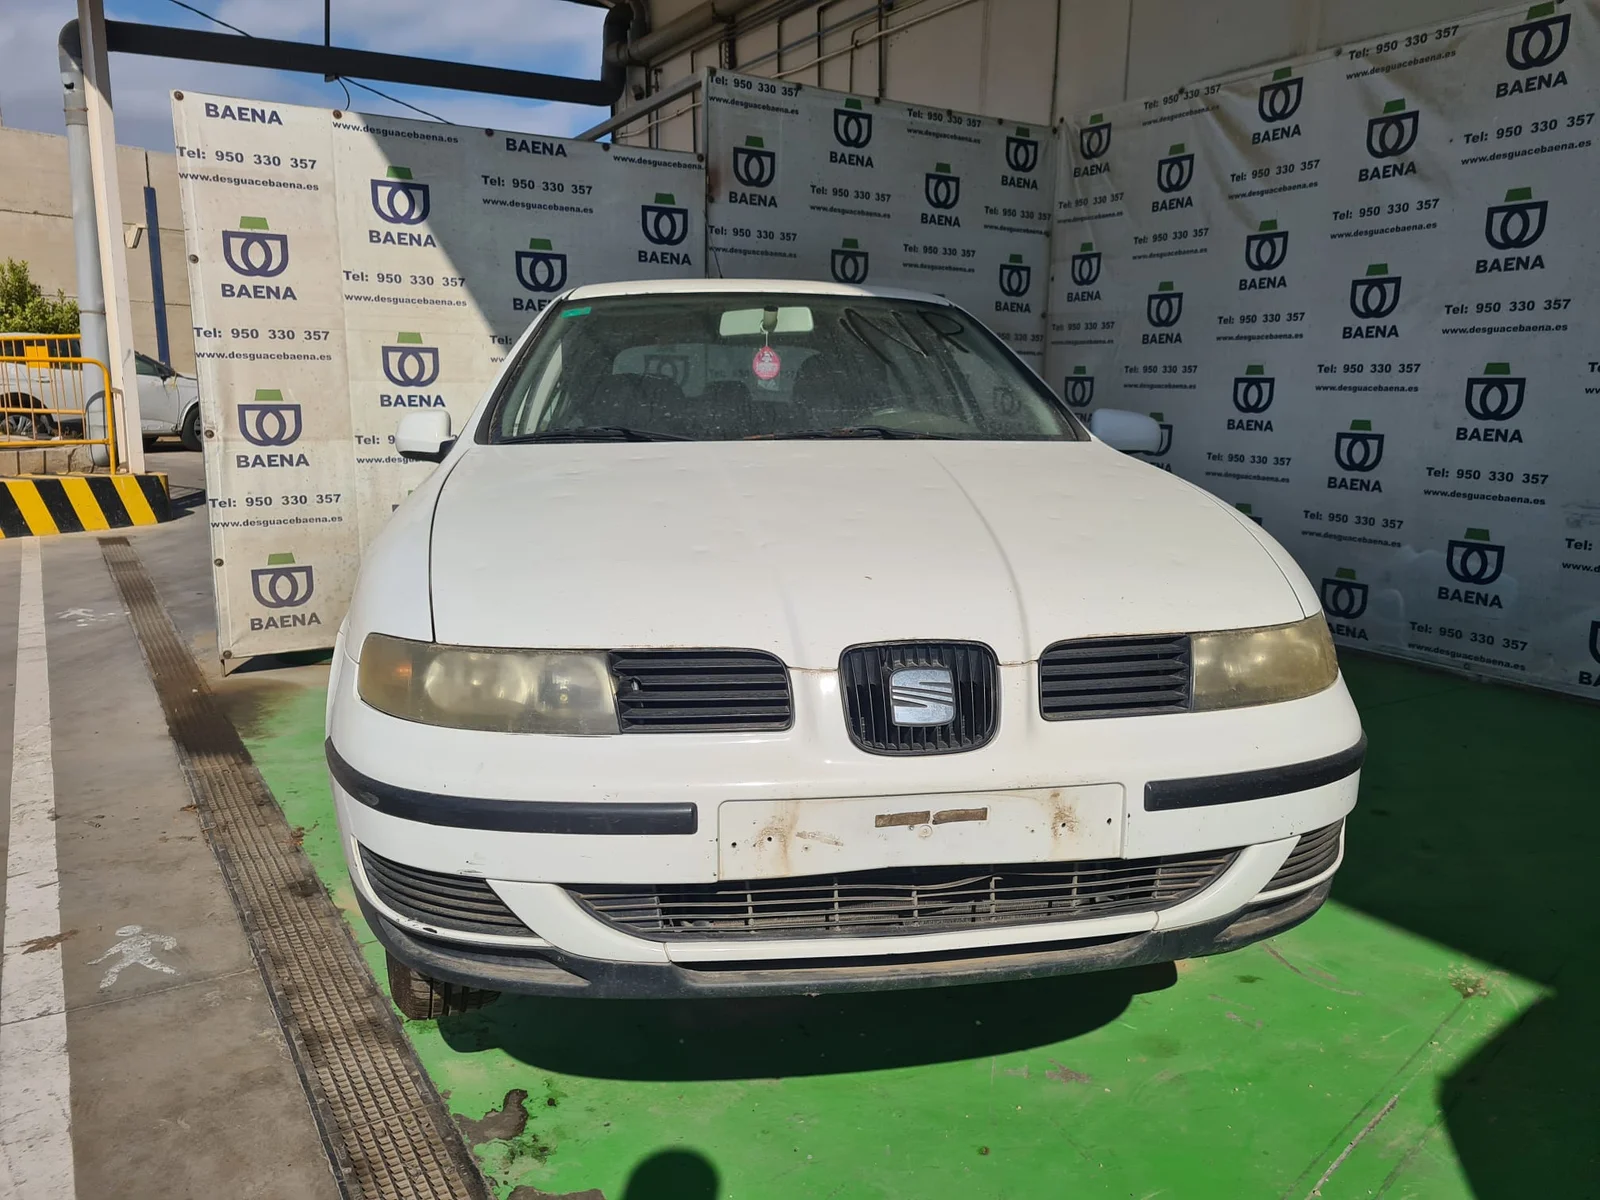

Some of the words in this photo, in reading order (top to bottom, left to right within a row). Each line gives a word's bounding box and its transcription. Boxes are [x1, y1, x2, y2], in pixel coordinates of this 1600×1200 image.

[1349, 48, 1369, 60] Tel:
[1376, 40, 1398, 54] 950
[1405, 33, 1427, 47] 330
[1435, 25, 1459, 41] 357
[1346, 50, 1456, 80] www.desguacebaena.es
[710, 74, 728, 86] Tel:
[733, 78, 752, 90] 950
[758, 82, 776, 94] 330
[781, 86, 800, 98] 357
[1496, 71, 1568, 98] BAENA
[1144, 101, 1159, 110] Tel:
[1162, 94, 1179, 105] 950
[1184, 89, 1200, 100] 330
[1204, 84, 1221, 95] 357
[204, 102, 283, 126] BAENA
[907, 108, 923, 119] Tel:
[927, 112, 943, 122] 950
[966, 118, 982, 128] 357
[332, 121, 459, 144] www.desguacebaena.es
[1252, 124, 1301, 145] BAENA
[1464, 131, 1488, 144] Tel:
[1496, 125, 1522, 139] 950
[1531, 120, 1557, 133] 330
[1566, 113, 1595, 127] 357
[506, 138, 567, 158] BAENA
[1461, 140, 1591, 165] www.desguacebaena.es
[176, 146, 206, 159] Tel:
[215, 150, 244, 163] 950
[253, 154, 281, 166] 330
[290, 157, 317, 170] 357
[613, 154, 704, 171] www.desguacebaena.
[829, 151, 874, 168] BAENA
[1073, 162, 1111, 178] BAENA
[1230, 173, 1247, 183] Tel:
[1252, 168, 1270, 179] 950
[1276, 164, 1295, 175] 330
[1300, 159, 1320, 171] 357
[1358, 161, 1416, 182] BAENA
[178, 172, 319, 191] www.desguacebaena.es
[481, 174, 505, 187] Tel:
[512, 178, 535, 190] 950
[542, 181, 564, 193] 330
[571, 184, 593, 195] 357
[1001, 175, 1038, 190] BAENA
[729, 191, 778, 208] BAENA
[810, 184, 828, 195] Tel:
[832, 188, 849, 198] 950
[854, 190, 870, 200] 330
[875, 192, 891, 202] 357
[482, 198, 594, 214] www.desguacebaena.es
[984, 206, 999, 215] Tel:
[1002, 208, 1017, 217] 950
[1020, 210, 1034, 219] 330
[1152, 196, 1193, 213] BAENA
[1332, 210, 1352, 221] Tel:
[1359, 206, 1380, 218] 950
[1387, 202, 1409, 214] 330
[1416, 198, 1440, 211] 357
[920, 213, 961, 228] BAENA
[368, 229, 437, 248] BAENA
[708, 225, 727, 235] Tel:
[733, 228, 751, 237] 950
[757, 230, 774, 240] 330
[780, 232, 797, 241] 357
[1133, 236, 1148, 245] Tel:
[1152, 233, 1168, 243] 950
[1172, 230, 1188, 240] 330
[1193, 228, 1209, 238] 357
[1330, 222, 1437, 240] www.desguacebaena.es
[638, 250, 692, 266] BAENA
[1475, 255, 1545, 274] BAENA
[343, 270, 369, 282] Tel:
[377, 273, 402, 284] 950
[410, 275, 434, 286] 330
[442, 277, 465, 287] 357
[1239, 276, 1287, 291] BAENA
[221, 283, 297, 300] BAENA
[344, 293, 467, 307] www.desguacebaena.es
[1067, 290, 1101, 302] BAENA
[513, 298, 551, 311] BAE
[995, 301, 1031, 314] BAENA
[1445, 304, 1468, 314] Tel:
[1476, 302, 1501, 313] 950
[1509, 300, 1535, 312] 330
[1543, 299, 1571, 310] 357
[1217, 316, 1234, 324] Tel:
[1239, 314, 1257, 324] 950
[1262, 314, 1280, 323] 330
[1286, 312, 1305, 322] 357
[193, 327, 222, 339] Tel:
[231, 328, 259, 339] 950
[268, 329, 295, 340] 330
[304, 330, 330, 341] 357
[1342, 324, 1399, 339] BAENA
[1442, 324, 1568, 335] www.desguacebaena.es
[490, 335, 512, 345] Tel:
[1142, 333, 1182, 345] BAENA
[194, 350, 332, 361] www.desguacebaena.es
[1143, 366, 1158, 374] 950
[1162, 366, 1177, 374] 330
[1182, 365, 1197, 374] 357
[1317, 364, 1337, 374] Tel:
[1343, 364, 1364, 373] 950
[1370, 364, 1391, 373] 330
[1398, 363, 1421, 373] 357
[1315, 384, 1418, 393] www.desguacebaena.es
[380, 394, 446, 407] BAENA
[1227, 419, 1273, 432] BAENA
[355, 435, 380, 445] Tel:
[1456, 427, 1523, 443] BAENA
[236, 453, 310, 468] BAENA
[1206, 452, 1223, 461] Tel:
[1228, 454, 1245, 463] 950
[1250, 455, 1267, 464] 330
[1273, 457, 1291, 466] 357
[1327, 476, 1382, 493] BAENA
[1426, 467, 1449, 478] Tel:
[1456, 469, 1480, 480] 950
[1488, 471, 1513, 483] 330
[1522, 473, 1548, 485] 357
[209, 498, 236, 508] Tel:
[245, 496, 272, 507] 950
[281, 495, 307, 505] 330
[316, 493, 341, 504] 357
[1424, 489, 1545, 505] www.desguacebaena.es
[211, 516, 343, 528] www.desguacebaena.es
[1303, 510, 1322, 520] Tel:
[1328, 513, 1348, 523] 950
[1354, 515, 1375, 526] 330
[1382, 518, 1403, 529] 357
[1301, 530, 1401, 548] www.desguacebaena.es
[1565, 538, 1593, 551] Tel:
[1437, 586, 1503, 609] BAENA
[251, 612, 321, 630] BAENA
[1329, 623, 1368, 641] AENA
[1409, 621, 1432, 634] Tel:
[1439, 627, 1463, 639] 950
[1470, 632, 1494, 645] 330
[1502, 638, 1528, 651] 357
[1408, 642, 1526, 671] www.desguacebaena.es
